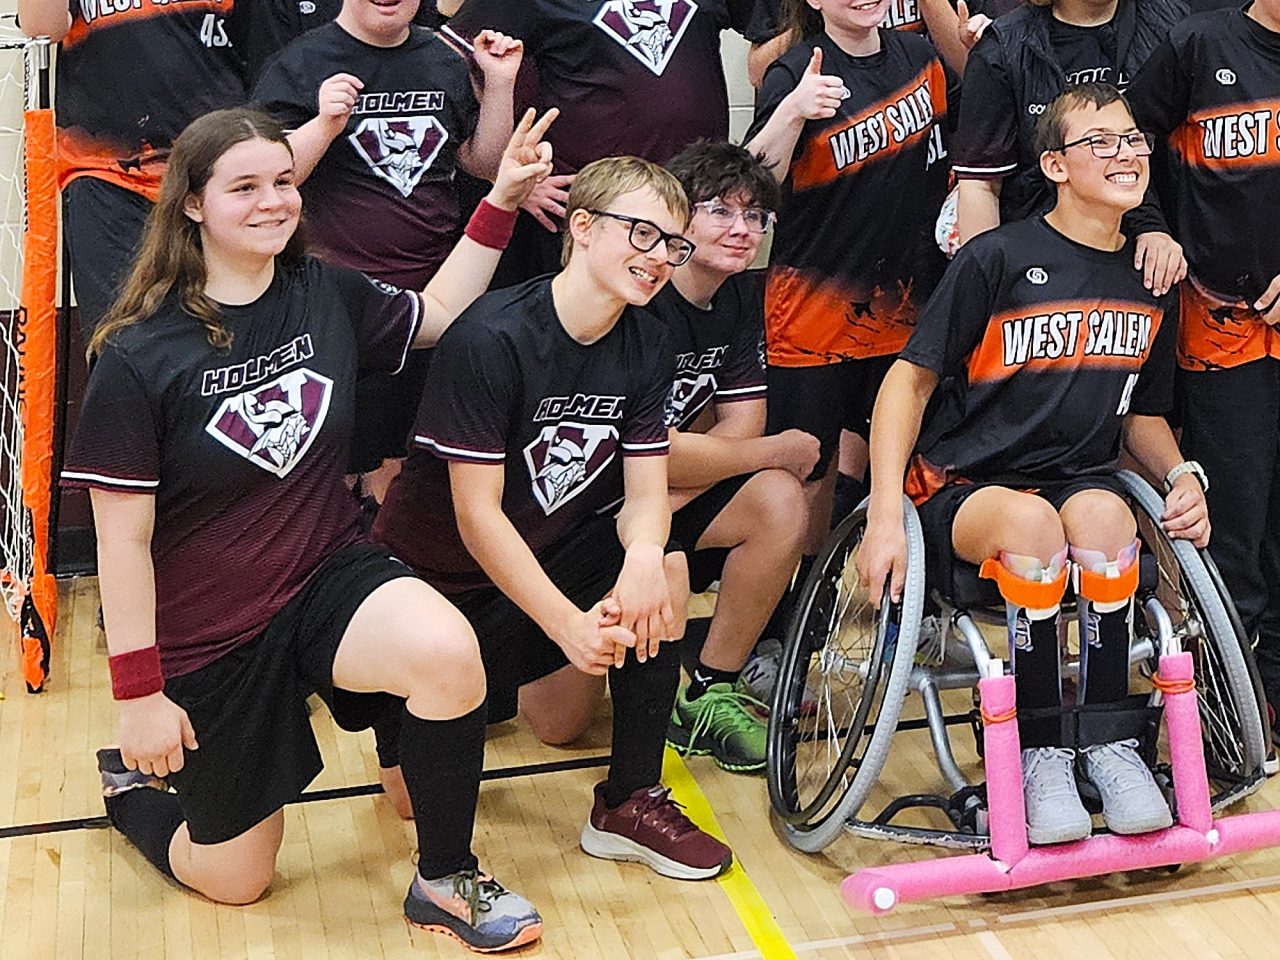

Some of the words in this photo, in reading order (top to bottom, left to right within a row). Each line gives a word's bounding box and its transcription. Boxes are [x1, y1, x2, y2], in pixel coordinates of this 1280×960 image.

[829, 111, 888, 171] WEST
[1200, 110, 1271, 159] WEST
[201, 333, 315, 396] HOLMEN
[1002, 311, 1084, 367] WEST
